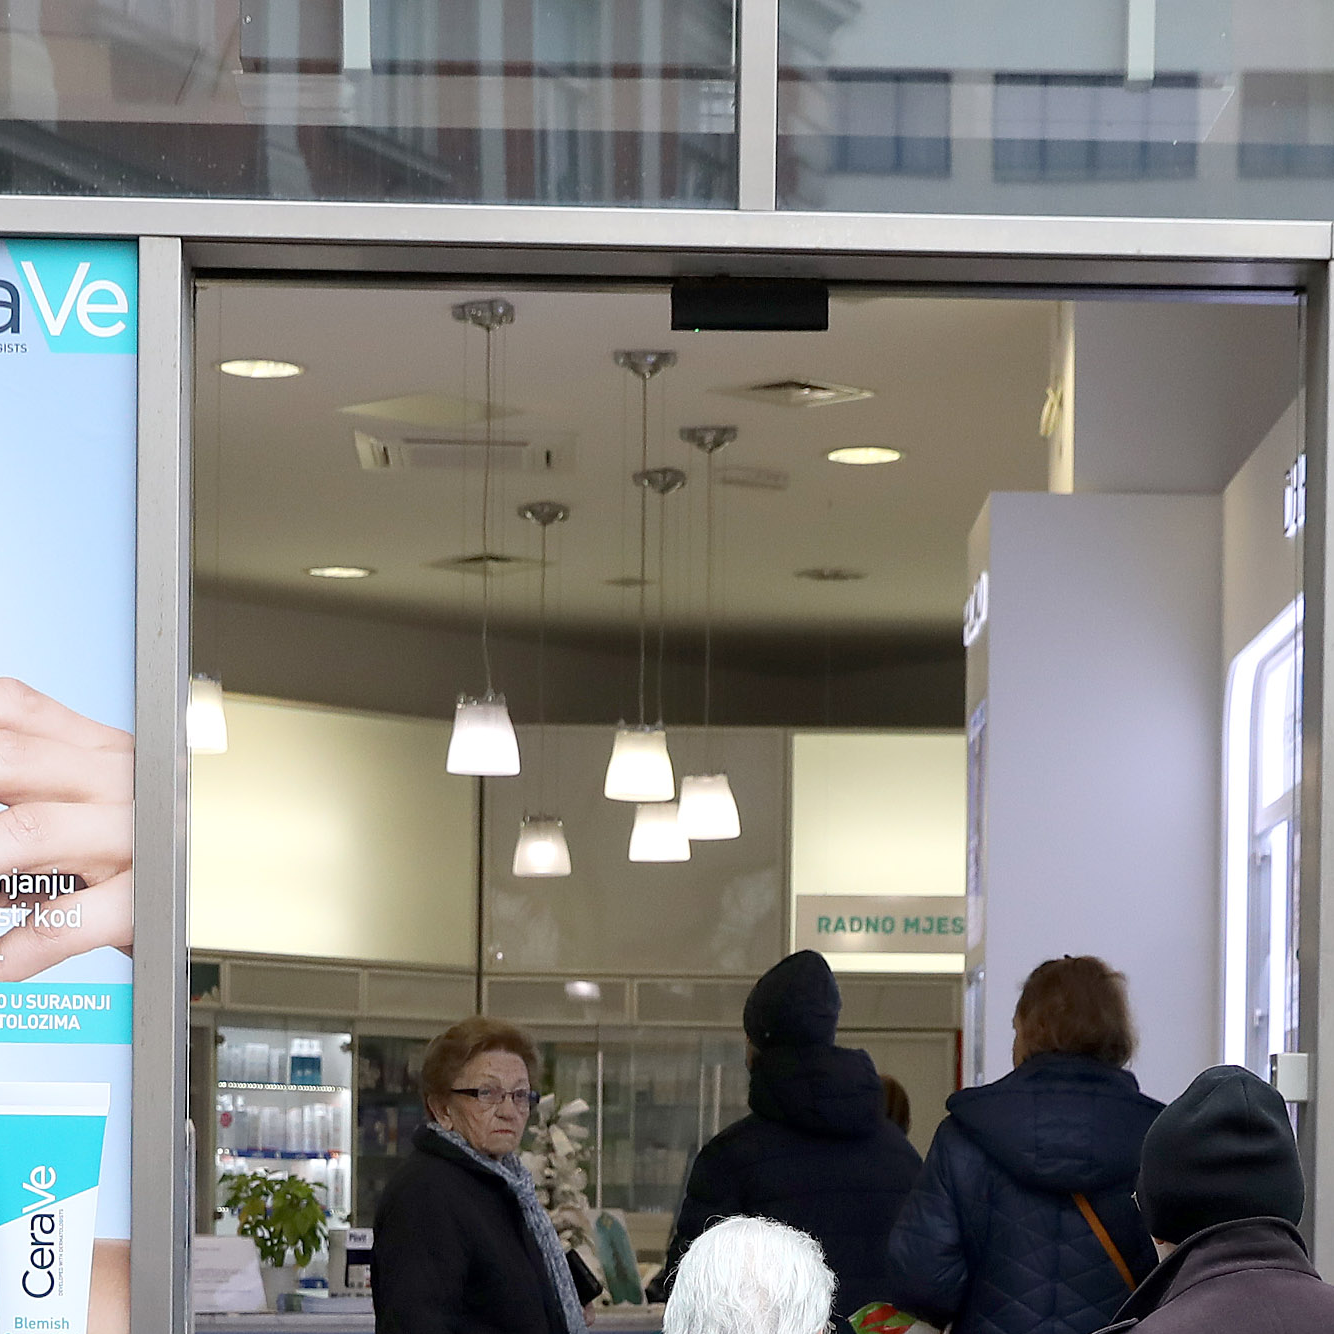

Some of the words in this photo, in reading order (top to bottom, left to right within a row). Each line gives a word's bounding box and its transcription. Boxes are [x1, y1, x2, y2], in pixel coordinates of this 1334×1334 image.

[34, 903, 82, 928] kod
[817, 916, 895, 934] RADNO
[11, 994, 23, 1009] U
[25, 994, 111, 1010] SURADNJI
[21, 1165, 57, 1298] CeraVe
[15, 1316, 69, 1330] Blemish
